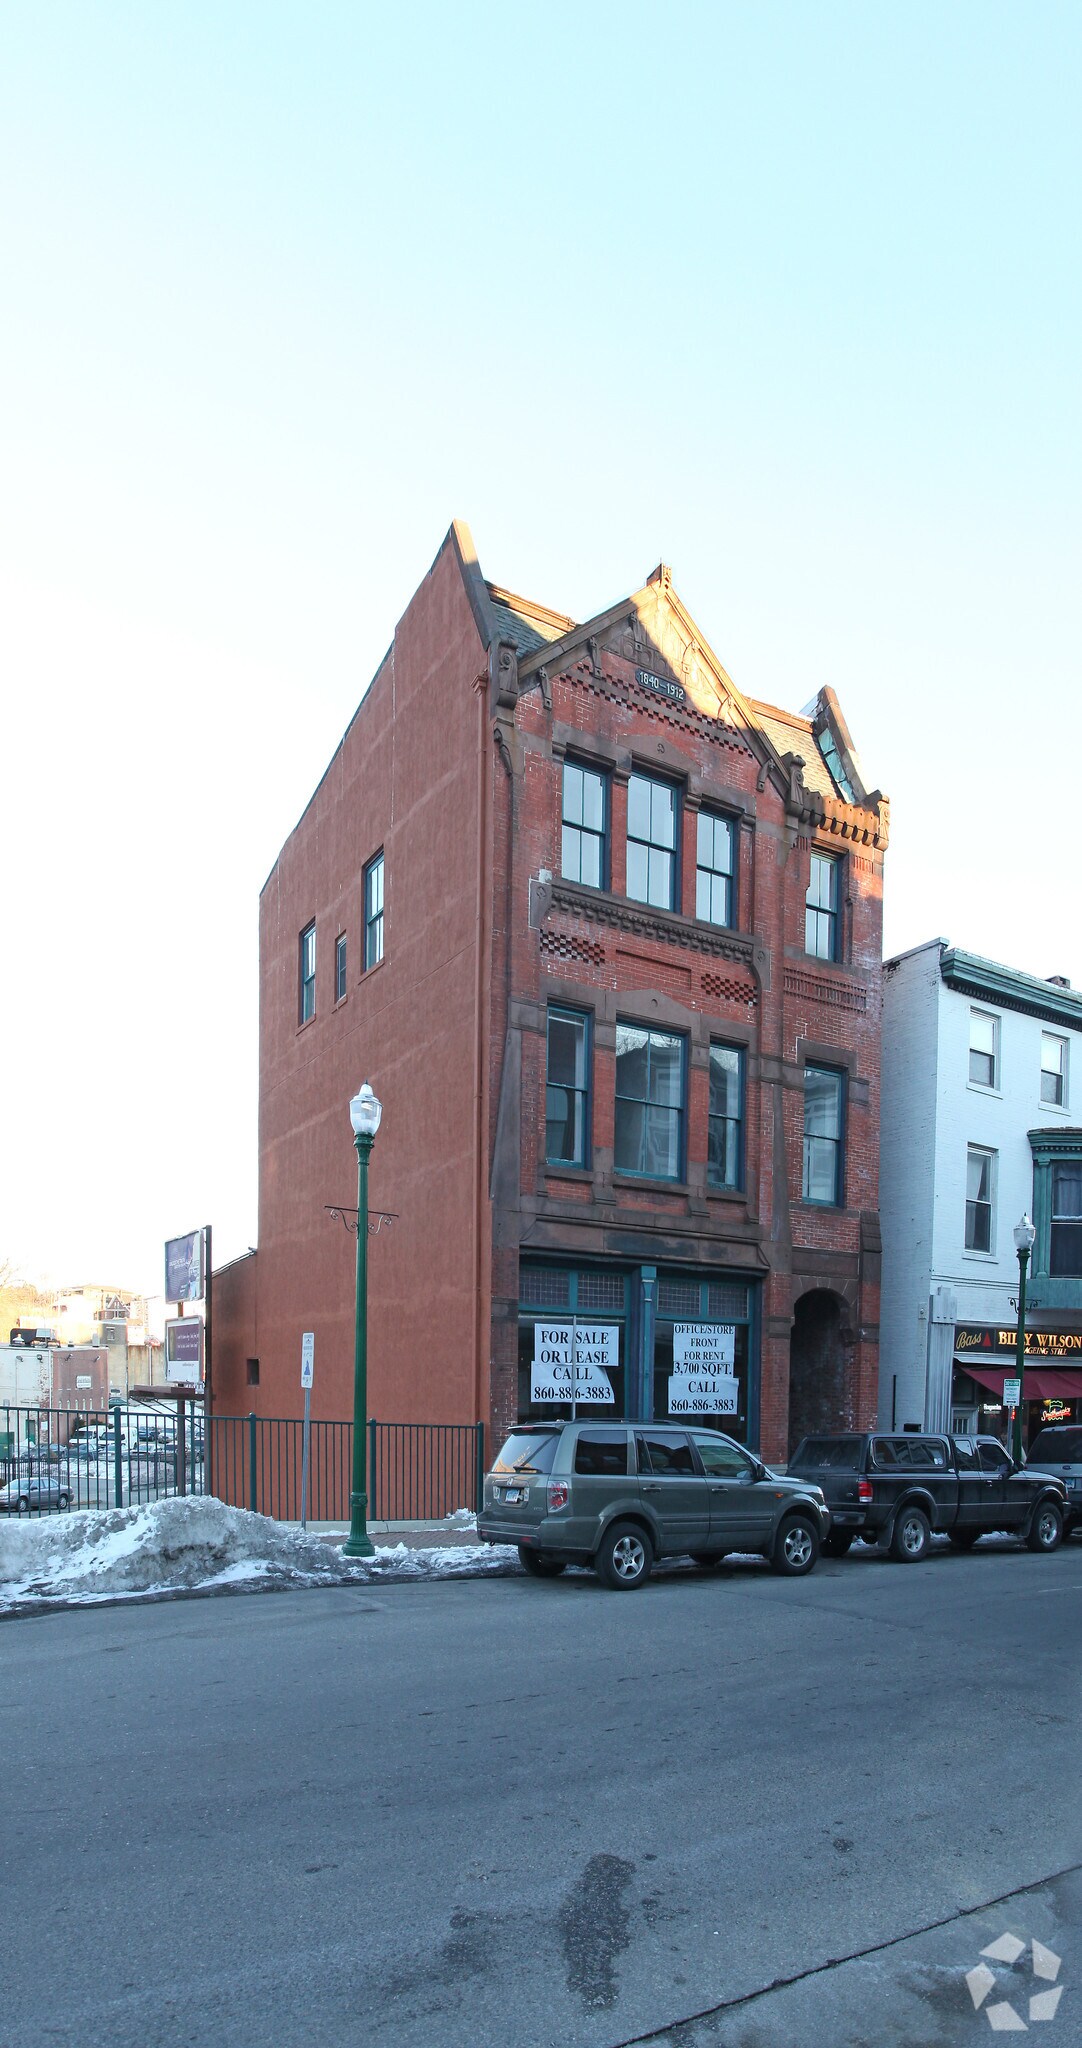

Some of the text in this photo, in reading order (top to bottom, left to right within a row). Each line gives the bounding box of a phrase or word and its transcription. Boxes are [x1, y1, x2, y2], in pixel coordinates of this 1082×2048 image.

[674, 1324, 734, 1334] OFFICE/STORE
[541, 1331, 609, 1344] FOR SALE
[690, 1338, 718, 1347] FRONT
[956, 1331, 982, 1349] Bass
[998, 1331, 1033, 1346] BILY
[541, 1350, 609, 1363] OR LEASE
[684, 1351, 725, 1360] FOR RENT
[1023, 1346, 1067, 1356] AGEING STILL
[553, 1367, 592, 1380] CALL
[674, 1362, 732, 1377] 3,700 SQFT.
[534, 1386, 611, 1399] 860-886-3883
[688, 1381, 719, 1393] CALL
[671, 1399, 734, 1411] 860-886-3883
